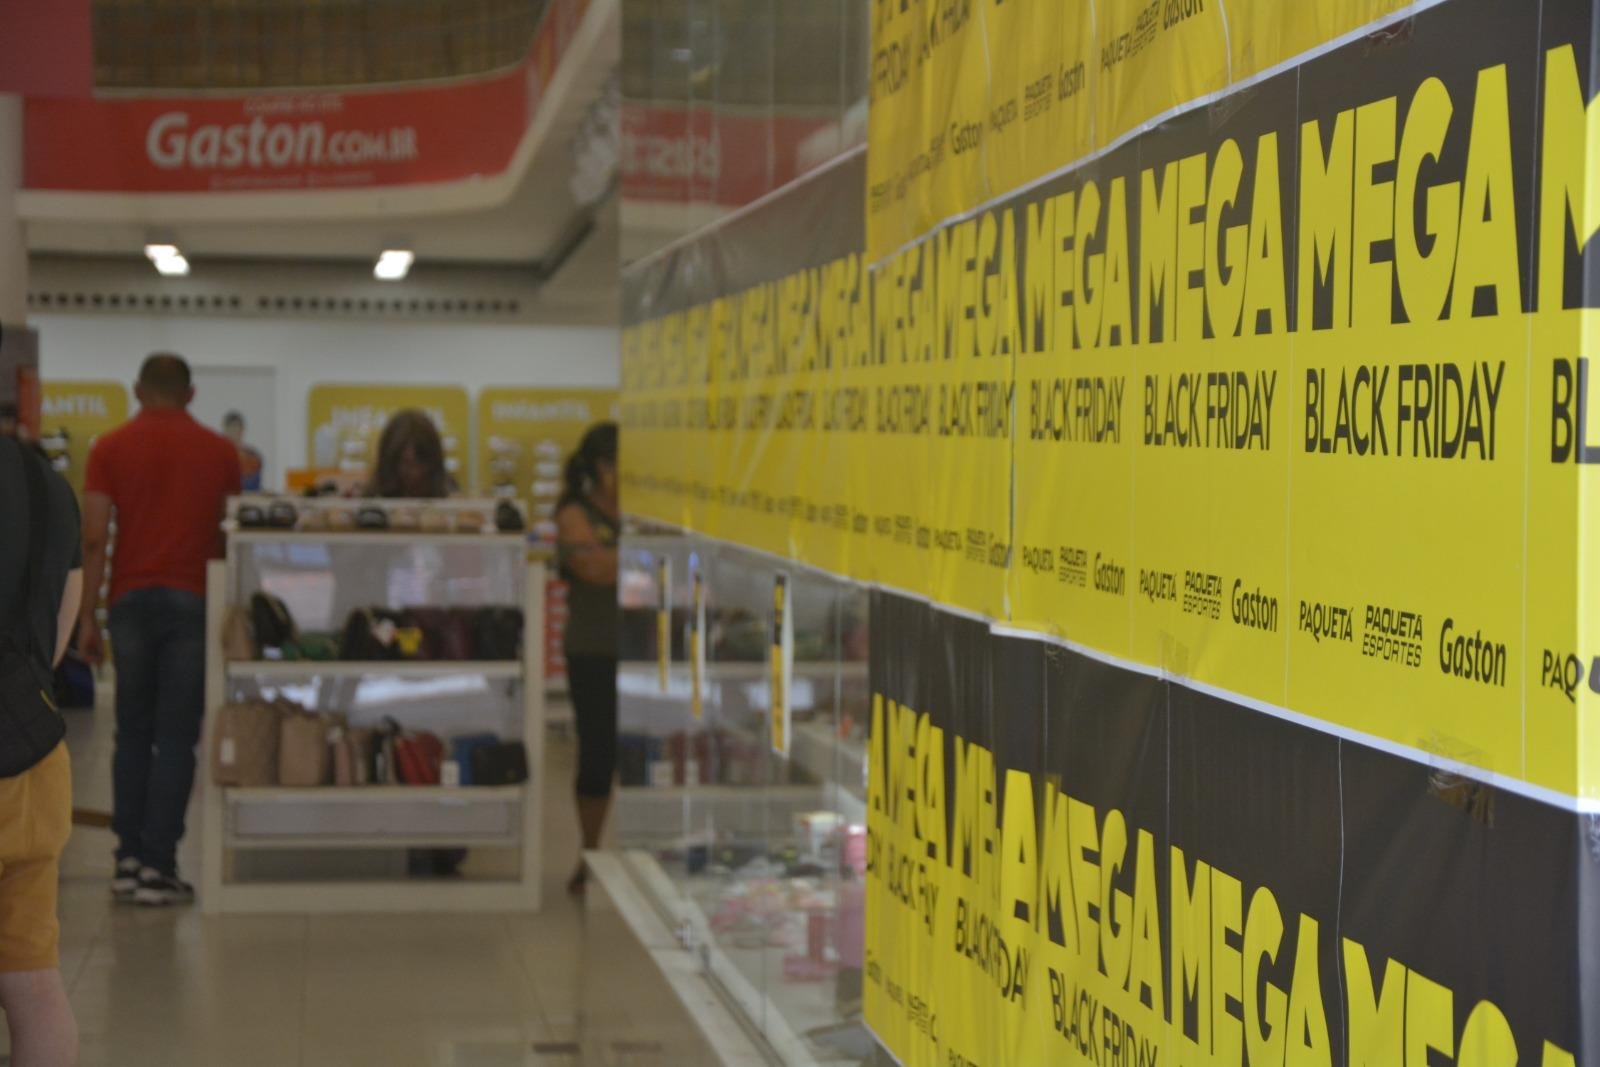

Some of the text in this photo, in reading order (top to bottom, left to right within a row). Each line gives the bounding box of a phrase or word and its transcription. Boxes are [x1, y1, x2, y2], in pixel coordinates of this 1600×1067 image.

[1138, 131, 1288, 344] MEGA
[1297, 63, 1522, 328] MEGA
[936, 208, 1023, 360] MEGA
[1025, 177, 1132, 352] MEGA
[1031, 375, 1125, 444] BLACK FRIDAY
[1144, 369, 1277, 451] BLACK FRIDAY
[1305, 360, 1506, 460] BLACK FRIDAY
[1094, 551, 1126, 596] Gaston
[1183, 593, 1221, 621] ESPORTES
[1231, 577, 1279, 633] Gaston
[1299, 599, 1354, 643] PAQUETÁ
[1362, 632, 1423, 669] ESPORTES
[1439, 617, 1507, 688] Gaston
[1037, 778, 1166, 1026] MEGA
[1170, 844, 1334, 1067] MEGA
[1048, 966, 1100, 1067] BLACK
